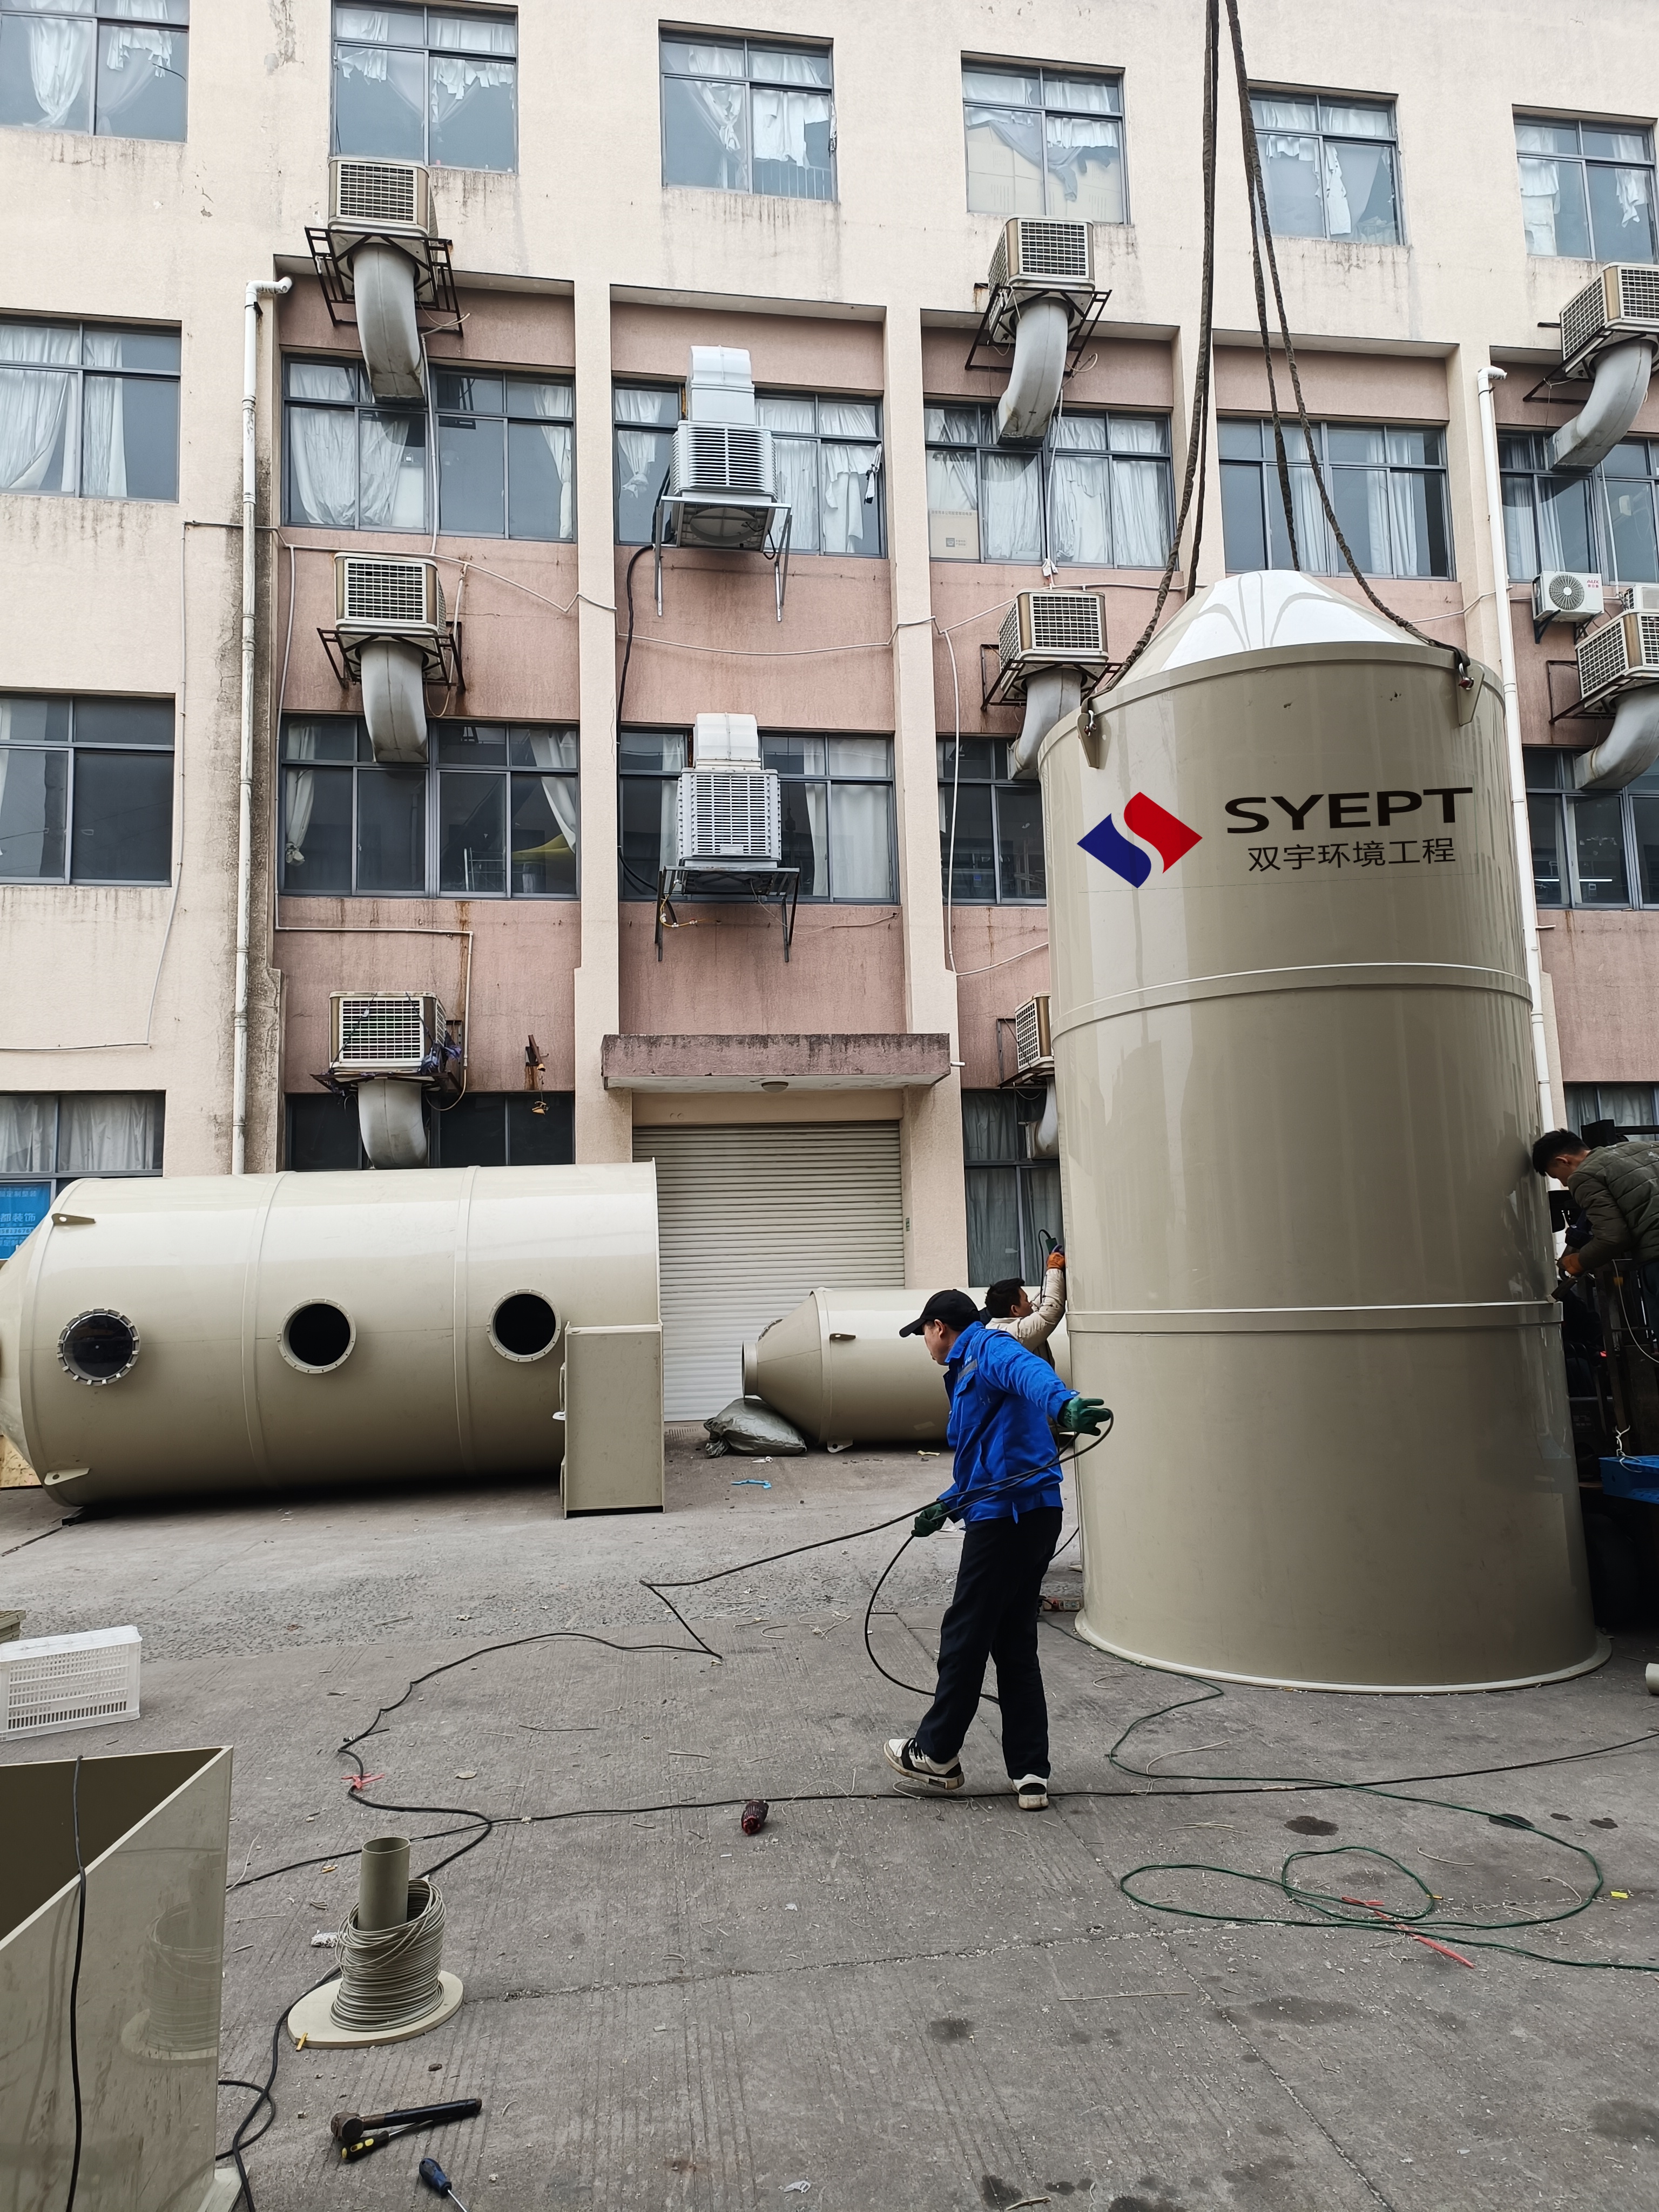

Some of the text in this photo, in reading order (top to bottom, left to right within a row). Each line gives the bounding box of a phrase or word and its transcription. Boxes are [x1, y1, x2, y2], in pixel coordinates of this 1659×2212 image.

[1225, 787, 1473, 834] SYEPT
[1247, 838, 1456, 872] 双宇环境工程
